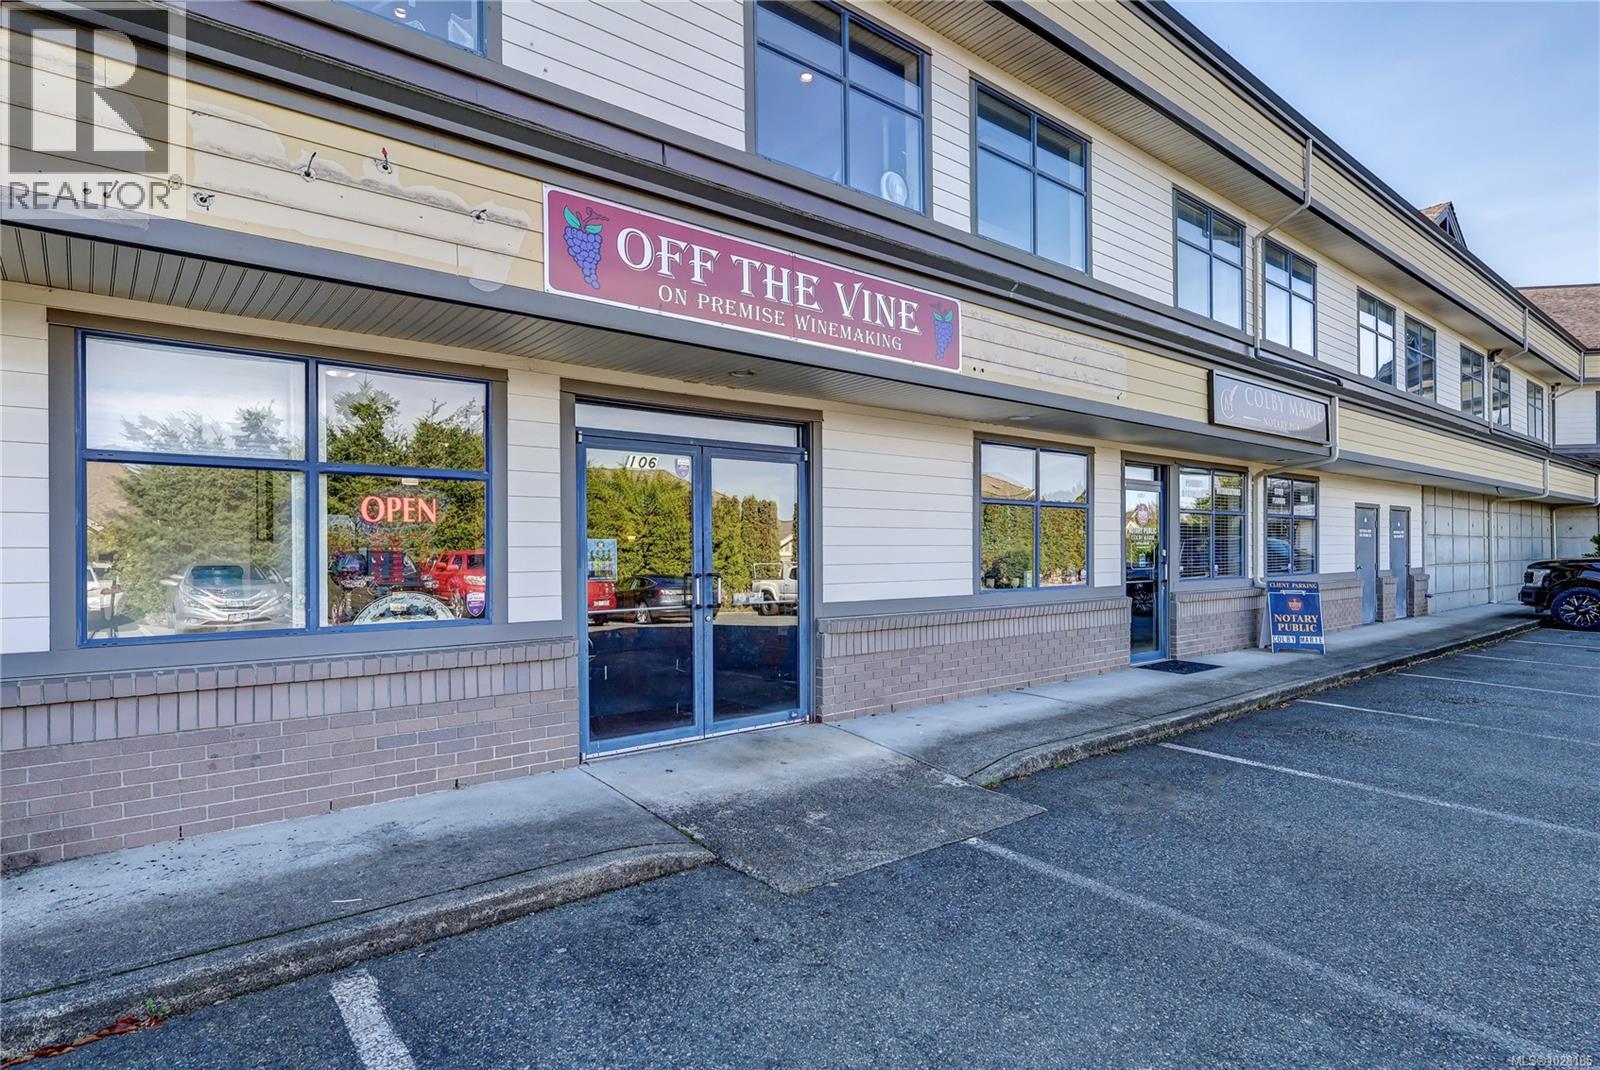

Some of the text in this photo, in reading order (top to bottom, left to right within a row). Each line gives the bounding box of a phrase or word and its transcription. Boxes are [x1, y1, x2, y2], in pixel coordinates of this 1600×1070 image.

[616, 227, 922, 335] OFF THE VINE
[658, 284, 902, 350] ON PREMISE WINEMAKING
[1244, 386, 1285, 413] COLBY
[630, 455, 657, 469] 106
[360, 495, 437, 523] OPEN
[1274, 614, 1319, 623] NOTARY
[1277, 623, 1317, 632] PUBLIC
